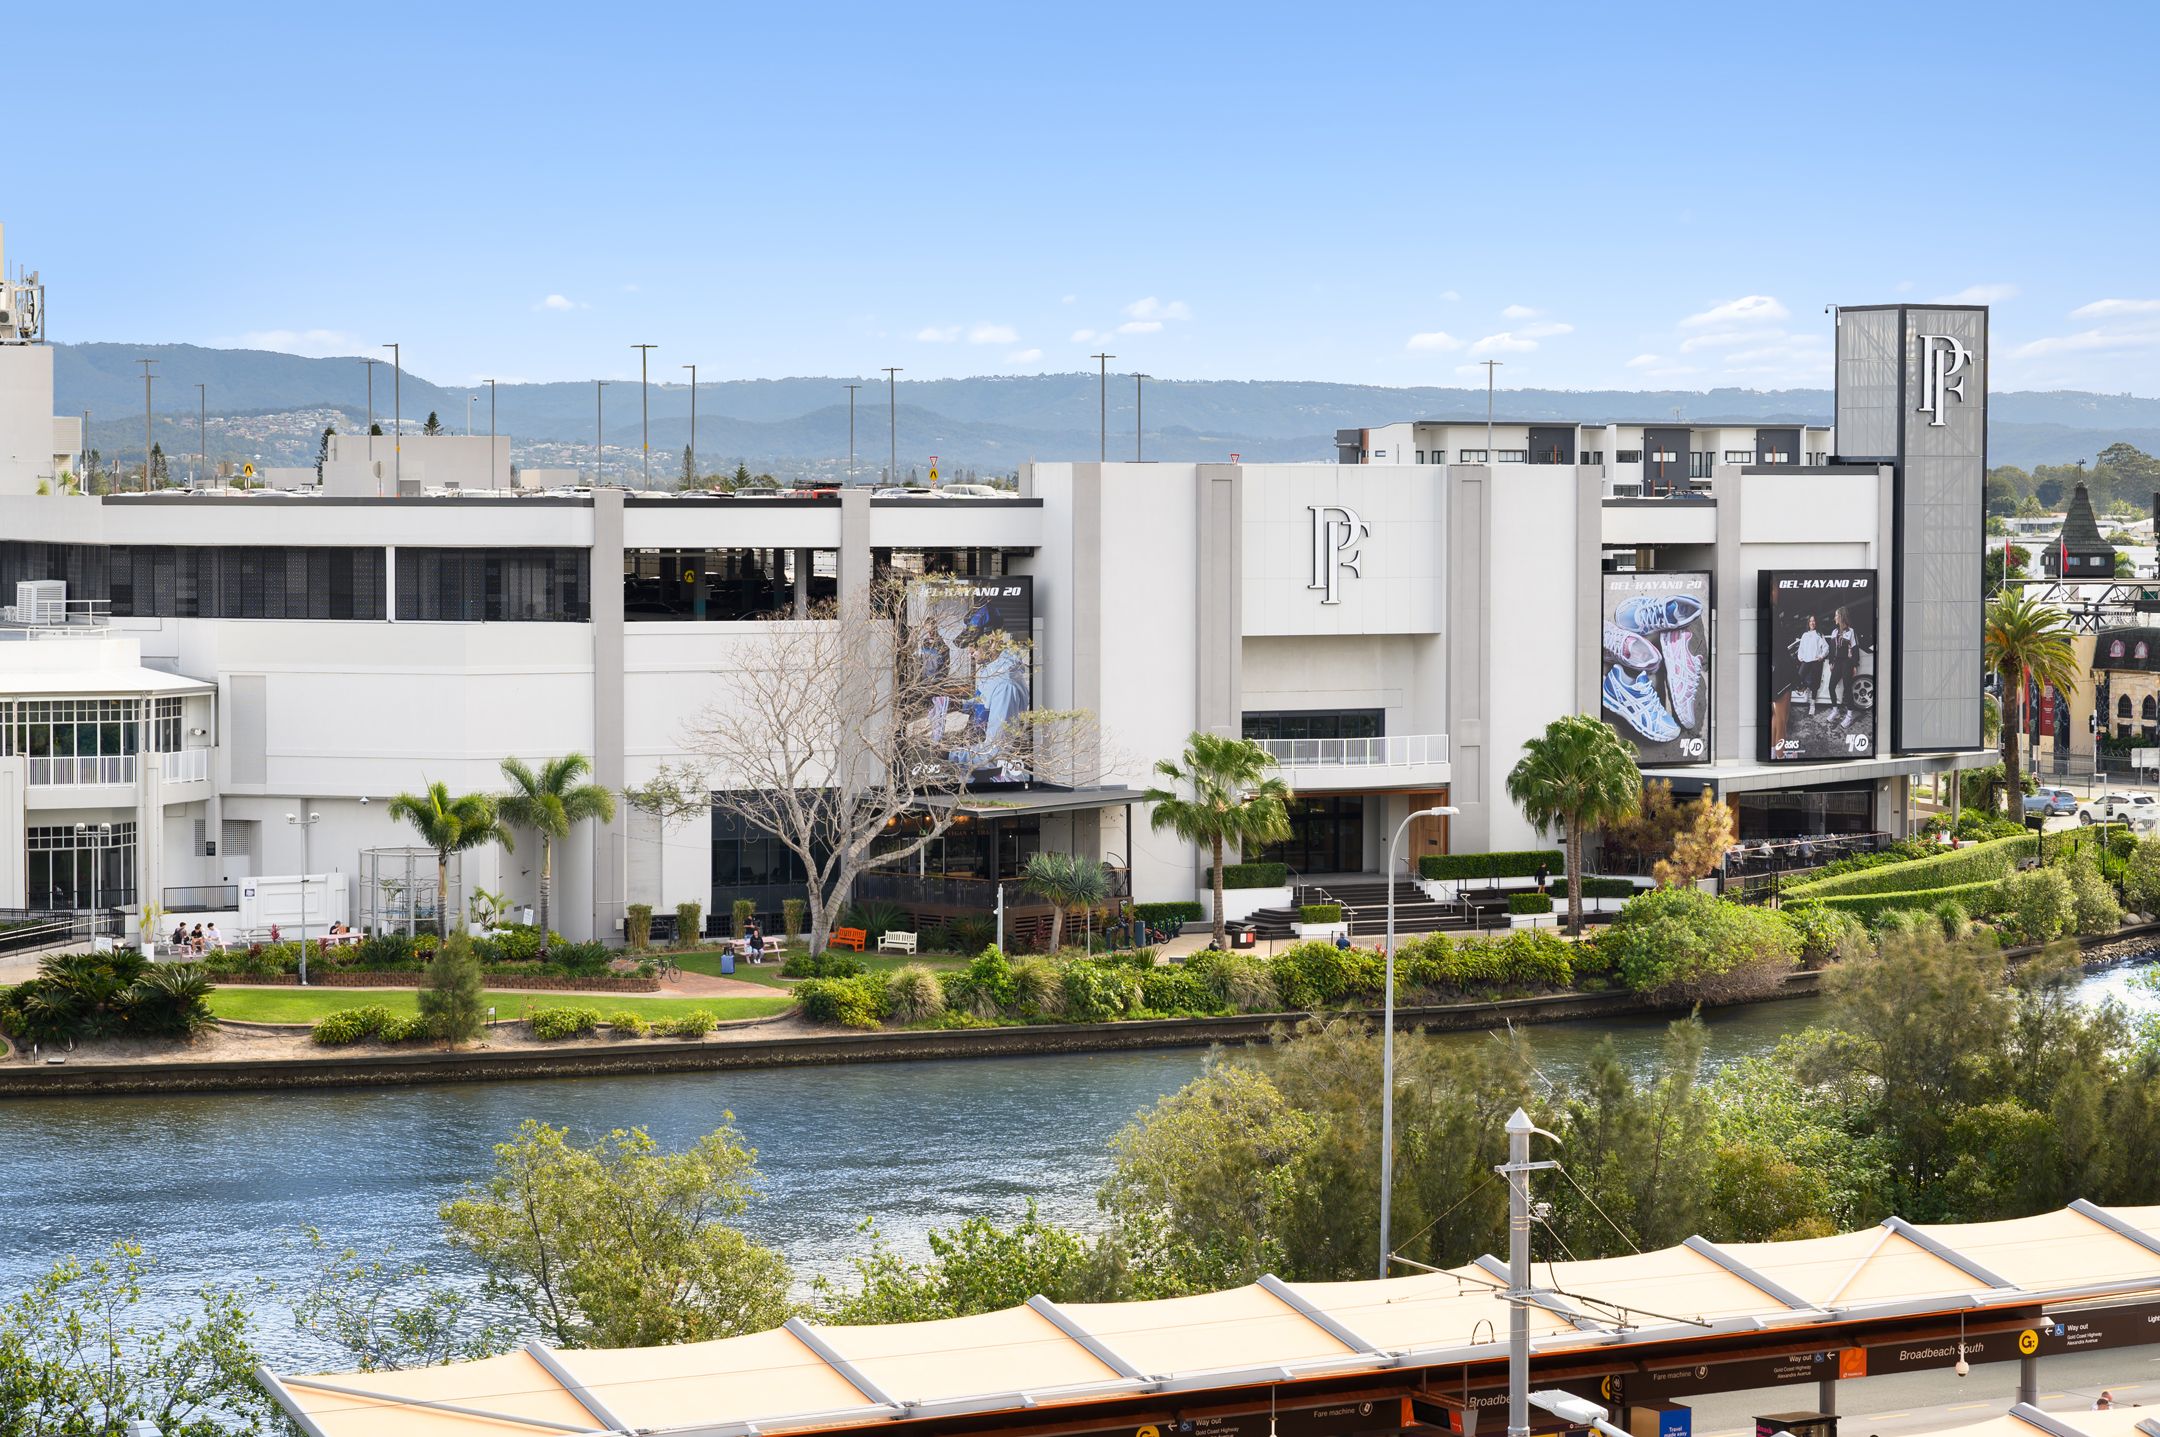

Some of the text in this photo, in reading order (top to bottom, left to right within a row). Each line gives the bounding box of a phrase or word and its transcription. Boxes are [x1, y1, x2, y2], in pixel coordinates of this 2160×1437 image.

[1610, 580, 1703, 590] GEL-KAYANO 20
[1779, 579, 1869, 589] GEL-KAYANO 20
[1002, 586, 1022, 597] 20
[2067, 1323, 2089, 1332] Way out
[1900, 1346, 1955, 1361] Broadbeach
[1789, 1355, 1801, 1363] Way
[1667, 1371, 1691, 1379] machine
[1469, 1394, 1511, 1408] Broadbe
[1313, 1407, 1355, 1418] Fare machine
[1195, 1419, 1209, 1427] Way
